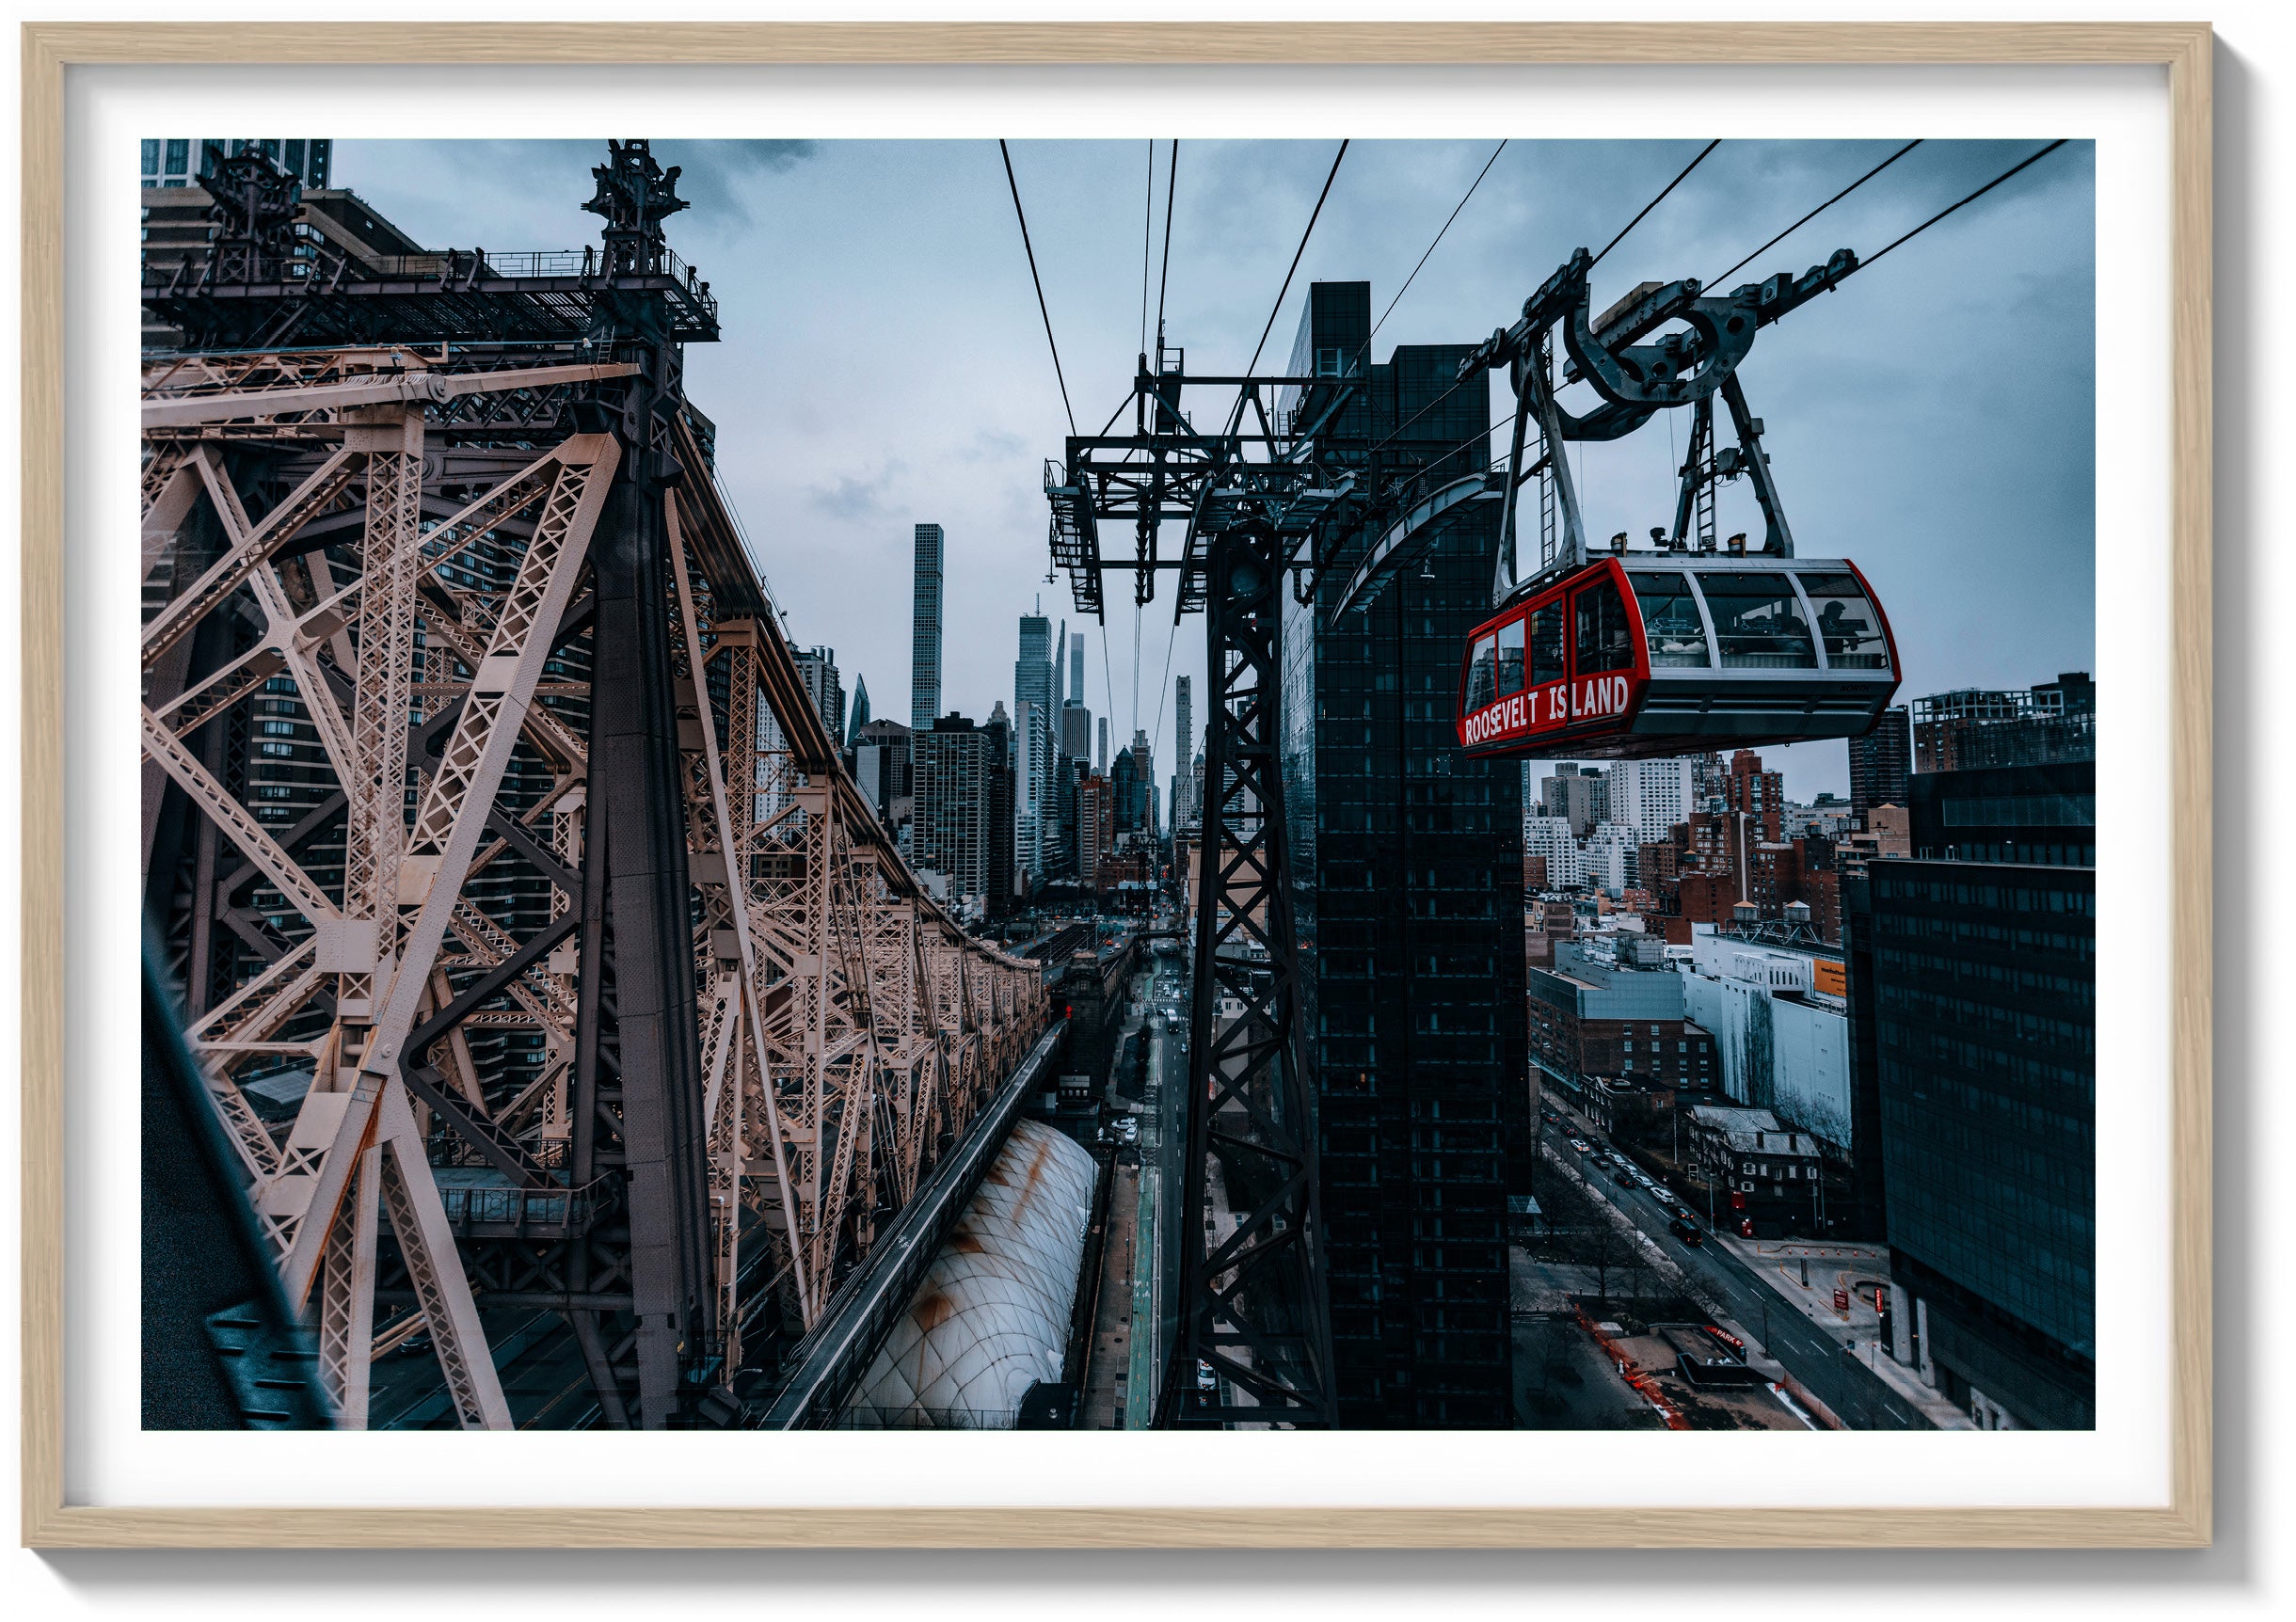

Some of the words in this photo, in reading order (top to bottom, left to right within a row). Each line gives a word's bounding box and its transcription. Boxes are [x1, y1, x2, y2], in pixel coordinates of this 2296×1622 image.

[1840, 684, 1870, 692] NORTH
[1465, 692, 1538, 745] ROOSEVELT
[1549, 676, 1628, 720] ISLAND
[1716, 1329, 1735, 1344] PARK
